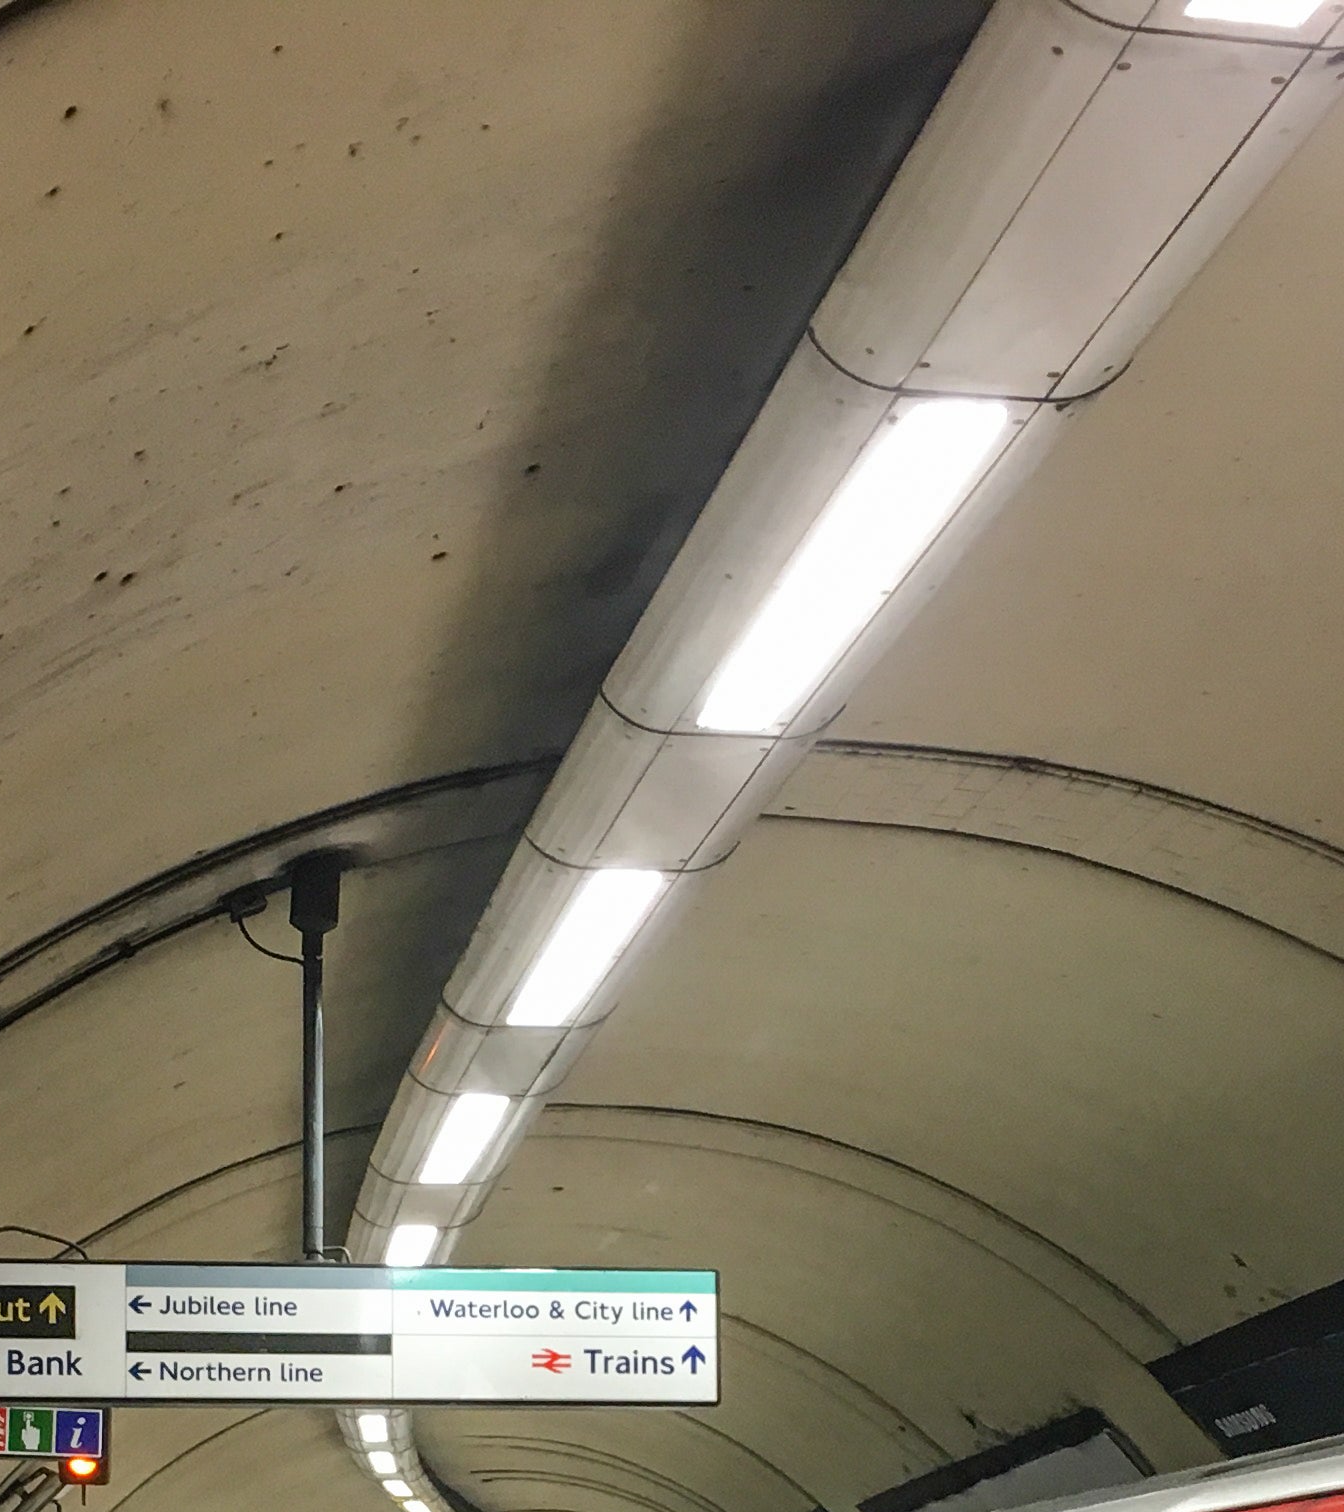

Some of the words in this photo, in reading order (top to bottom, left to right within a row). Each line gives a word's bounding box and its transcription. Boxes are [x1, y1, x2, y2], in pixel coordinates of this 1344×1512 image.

[159, 1295, 245, 1315] Jubilee
[255, 1297, 298, 1316] line
[430, 1299, 539, 1319] Waterloo
[549, 1301, 565, 1319] &
[575, 1301, 623, 1325] City
[632, 1302, 673, 1321] line
[7, 1350, 83, 1376] Bank
[159, 1361, 271, 1382] Northern
[280, 1363, 323, 1383] line
[583, 1349, 675, 1375] Trains
